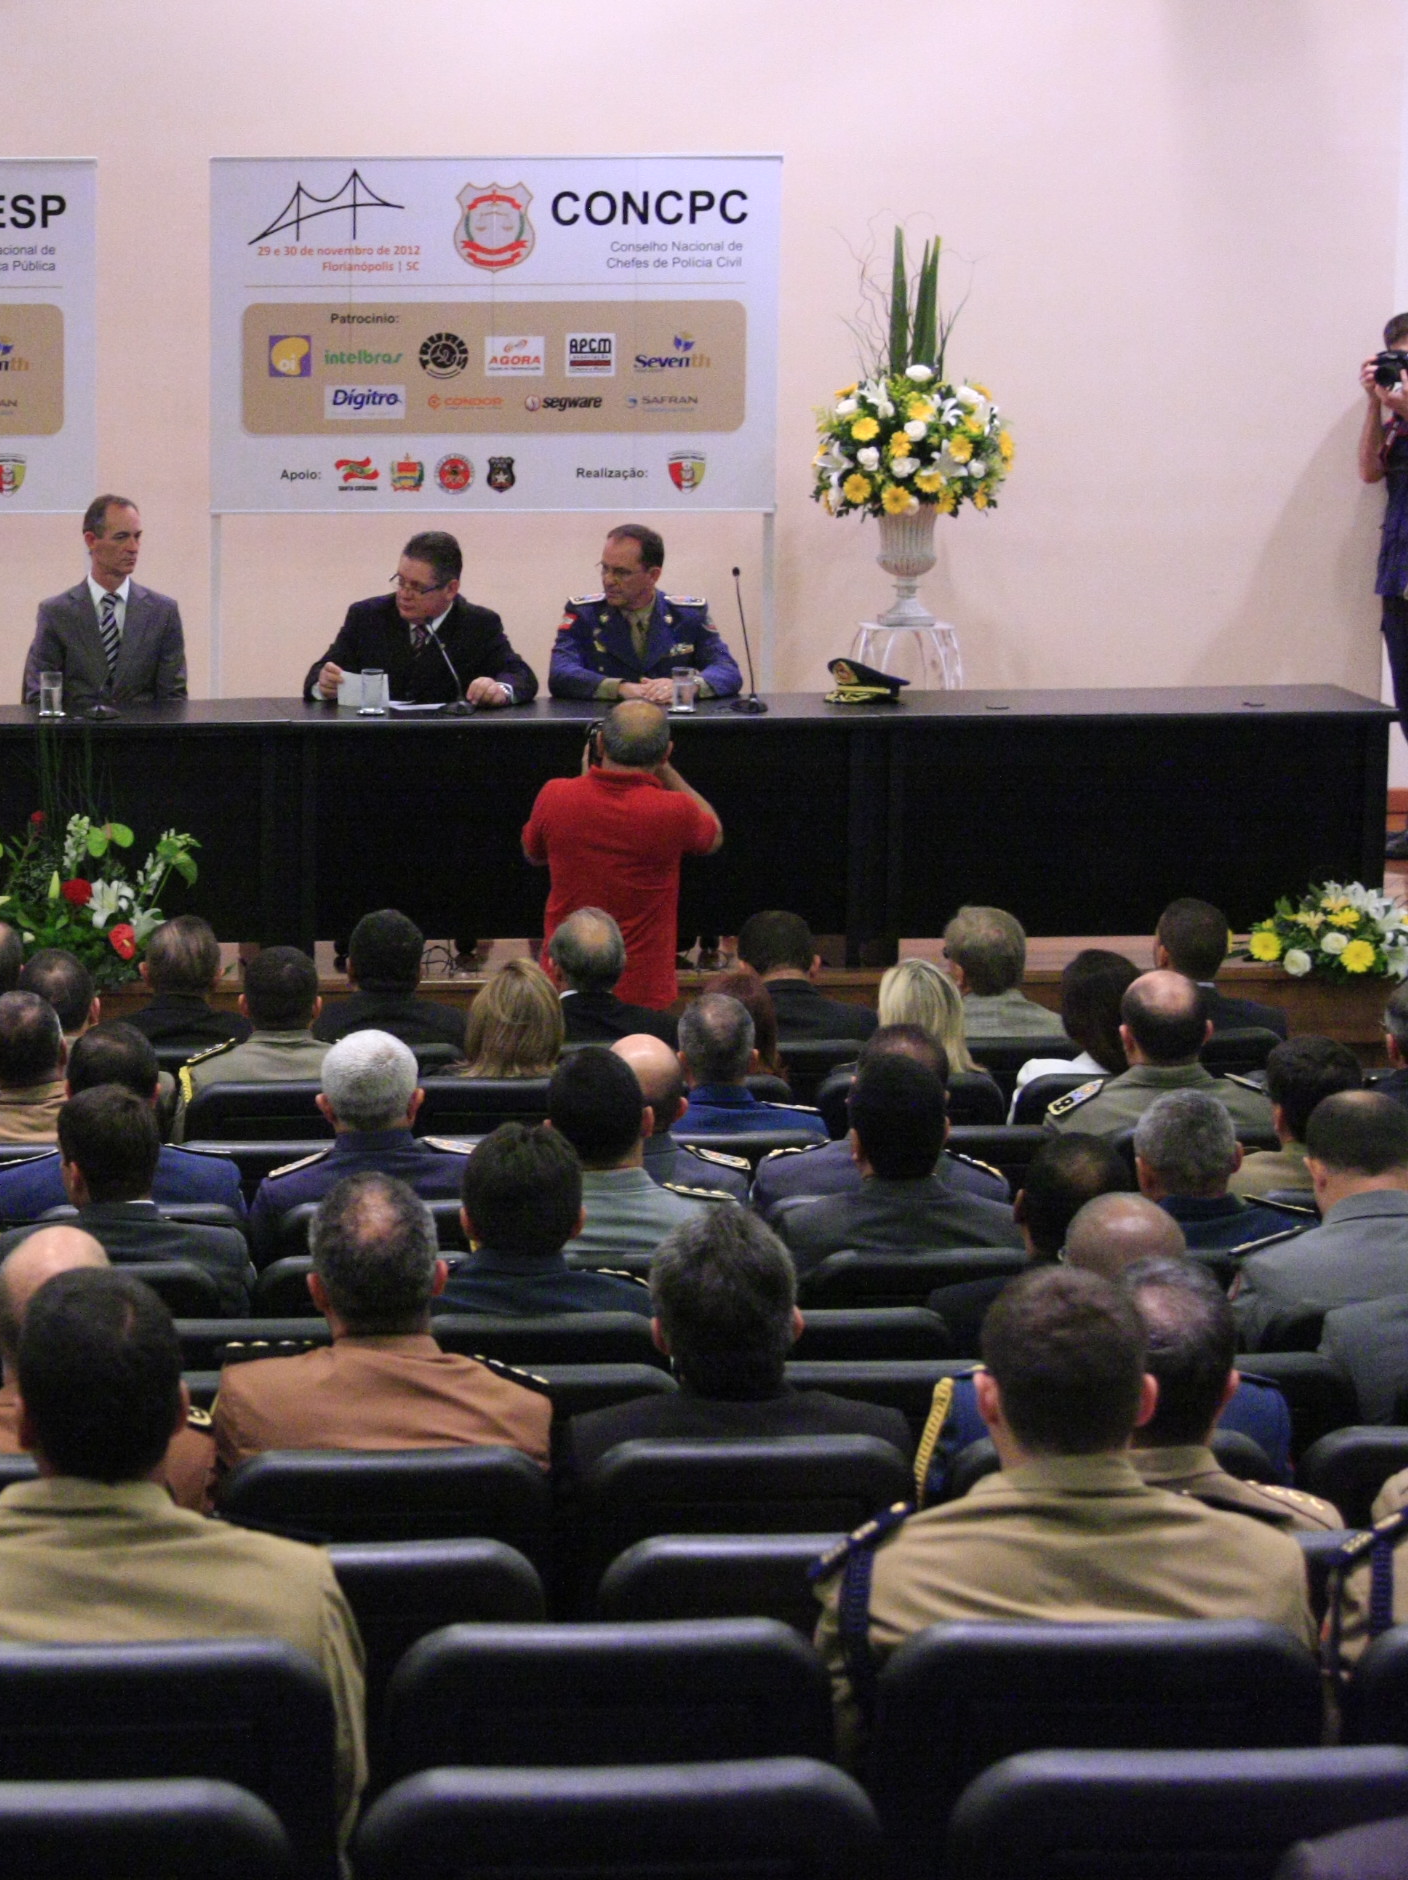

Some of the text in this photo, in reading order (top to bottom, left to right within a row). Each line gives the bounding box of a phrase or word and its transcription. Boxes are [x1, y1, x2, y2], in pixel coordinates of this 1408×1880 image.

[551, 189, 749, 226] CONCPC
[41, 245, 56, 255] de
[257, 245, 421, 256] 29 e 30 de novembro de 2012
[610, 240, 742, 252] Conselho Nacional de
[12, 260, 56, 271] Pública
[322, 261, 394, 273] Florianópolis
[406, 261, 420, 271] SC
[606, 257, 649, 269] Chefes
[653, 257, 668, 268] de
[716, 256, 742, 268] Civil
[569, 338, 611, 354] APCM
[279, 354, 296, 371] oi
[324, 350, 404, 365] intelbras
[488, 355, 541, 365] AGORA
[634, 353, 711, 369] Seventh
[542, 395, 603, 411] segware
[642, 395, 698, 405] SAFRAN
[280, 469, 322, 481] Apoio:
[576, 467, 648, 481] Realização:
